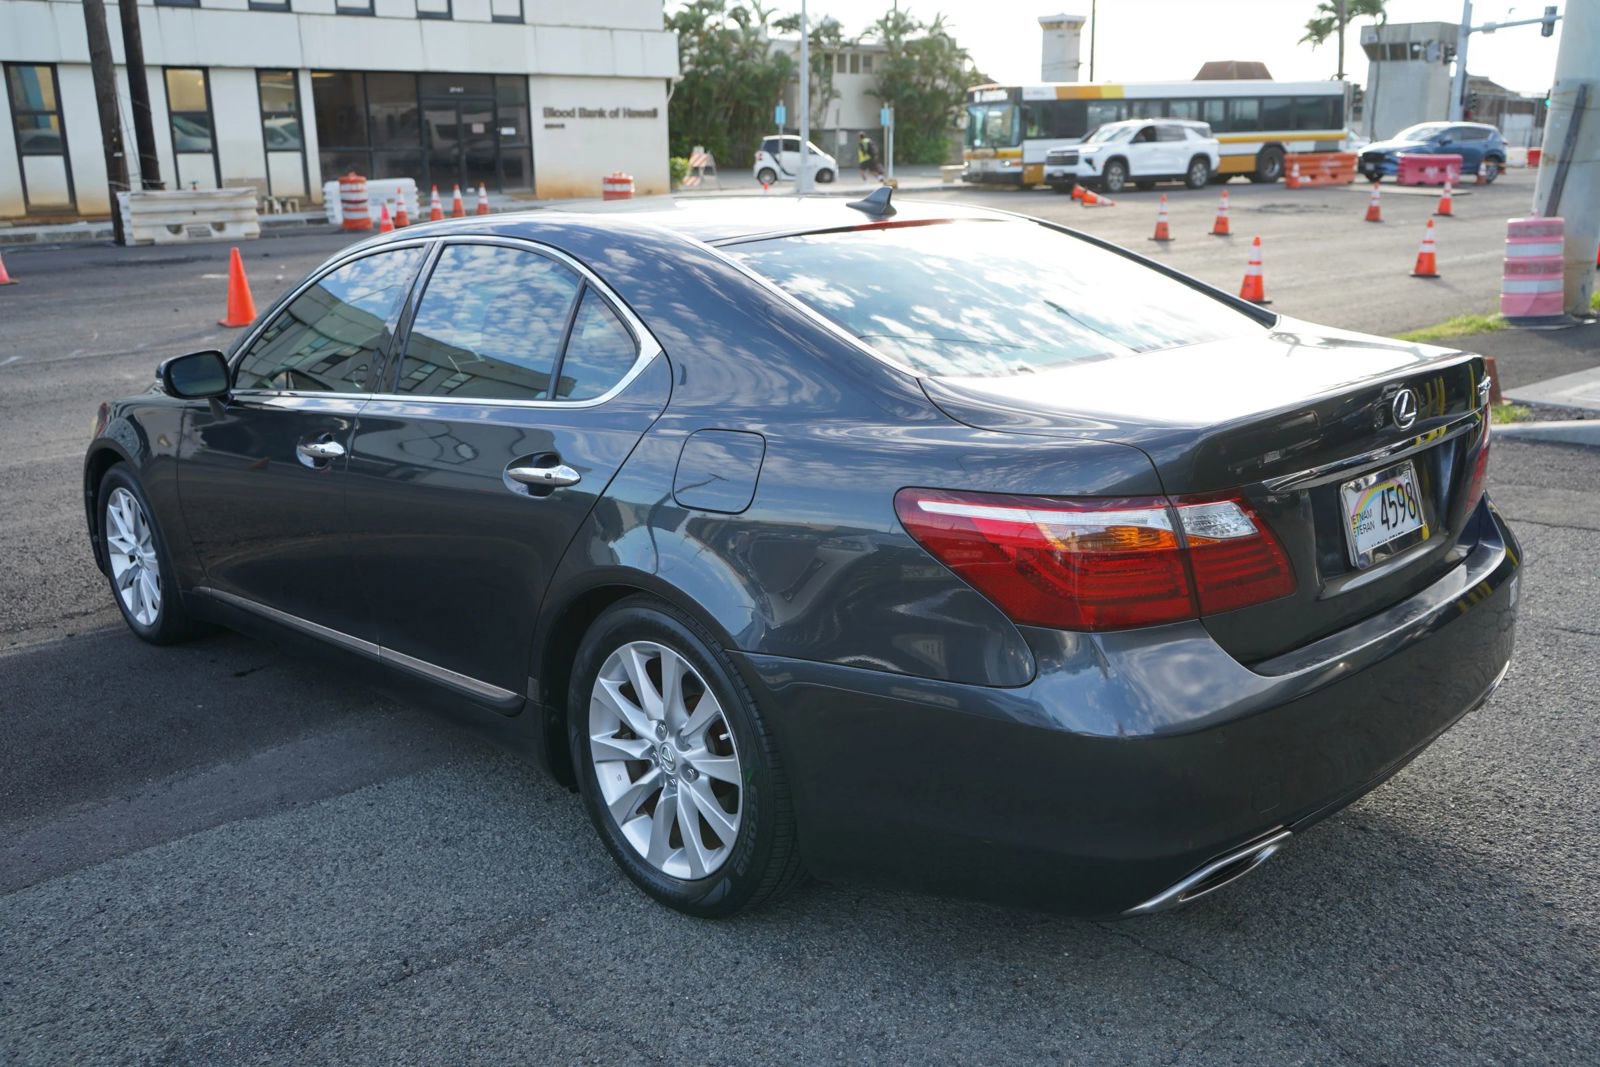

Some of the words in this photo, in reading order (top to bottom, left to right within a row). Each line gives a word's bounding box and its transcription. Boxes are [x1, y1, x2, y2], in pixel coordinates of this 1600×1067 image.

[543, 107, 576, 118] Blood
[578, 107, 607, 118] Bank
[609, 107, 620, 118] of
[1380, 482, 1416, 531] 4598
[1351, 508, 1373, 524] ETNAM
[1353, 521, 1375, 537] ETERAN
